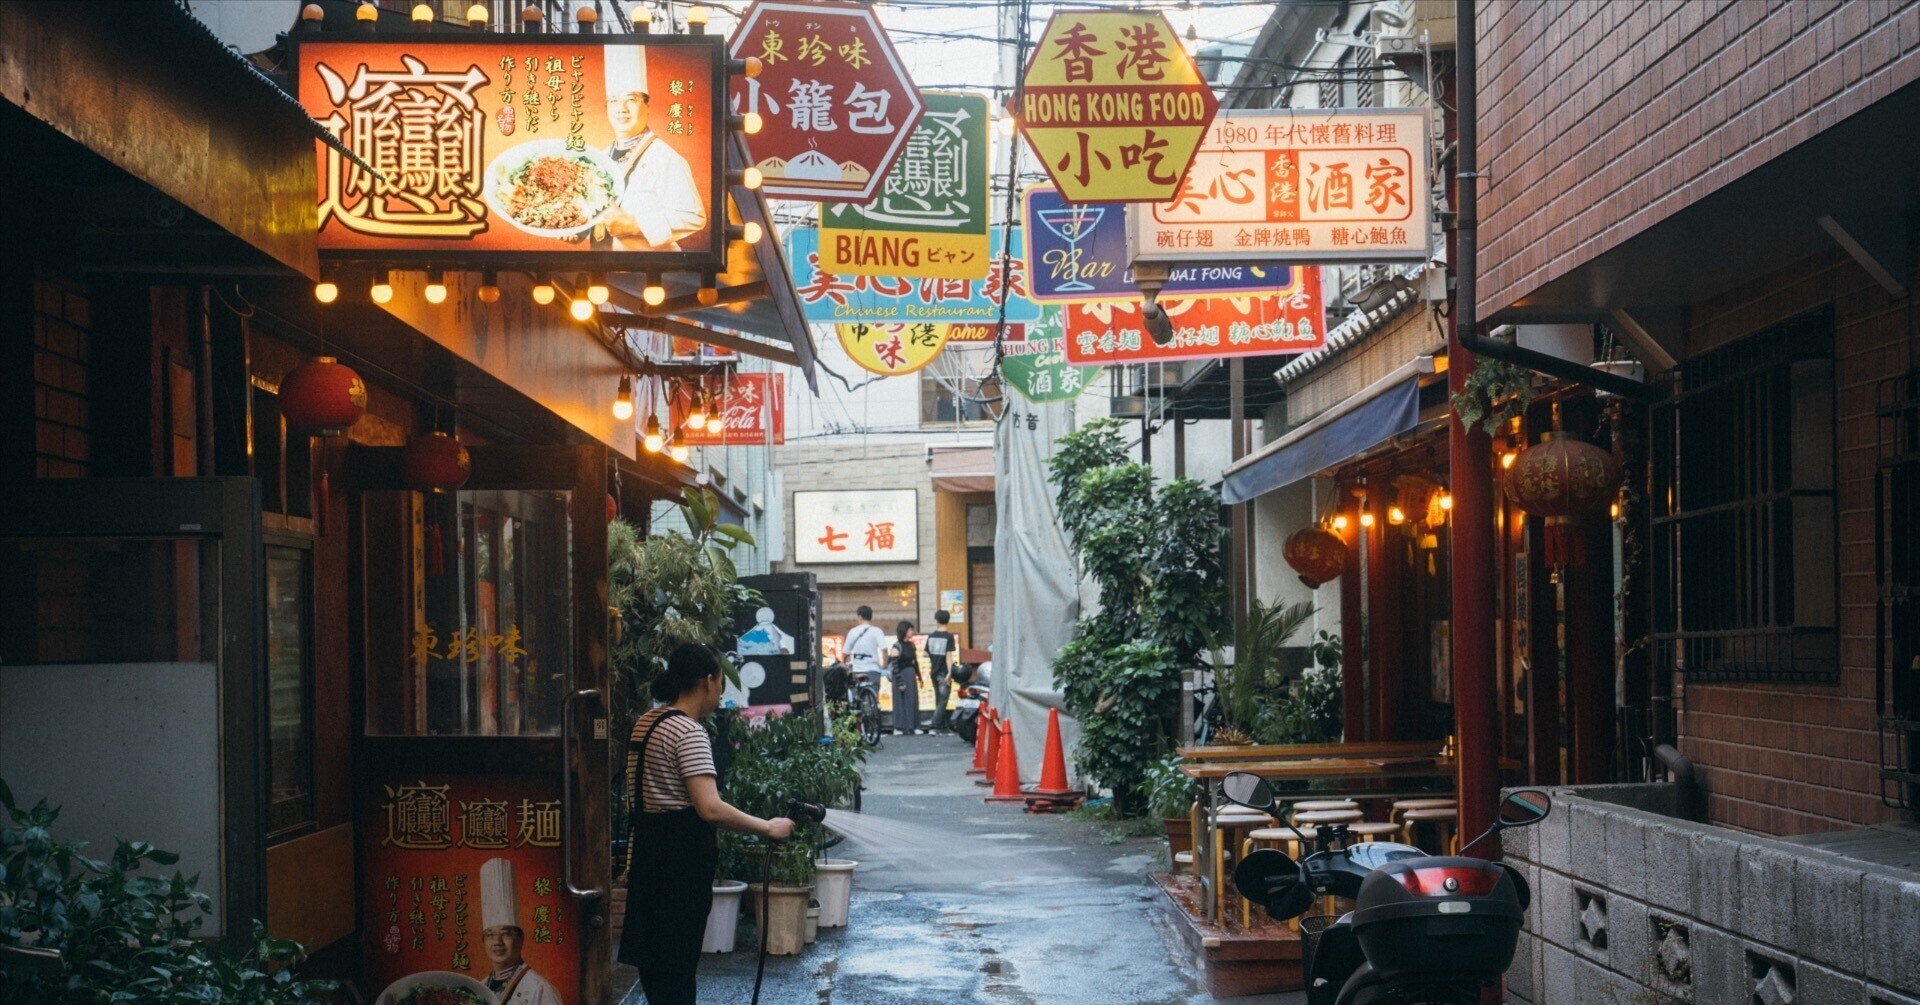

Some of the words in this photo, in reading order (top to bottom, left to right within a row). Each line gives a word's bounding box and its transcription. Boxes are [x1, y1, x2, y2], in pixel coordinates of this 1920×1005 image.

[758, 30, 872, 70] 東珍味
[1051, 22, 1172, 84] 香港
[498, 55, 517, 104] 作り方
[522, 56, 541, 133] 引き継いだ
[545, 55, 567, 122] 祖母から
[731, 77, 895, 135] 小籠包
[1024, 92, 1080, 123] HONG
[1086, 92, 1144, 122] KONG
[1149, 92, 1205, 121] FOOD
[1214, 125, 1259, 146] 1980
[1057, 129, 1177, 187] 小吃
[1269, 157, 1297, 203] 香港
[1305, 156, 1407, 214] 酒家
[836, 234, 920, 267] BIANG
[927, 248, 975, 264] ビャン
[1155, 228, 1214, 248] 碗仔翅
[1233, 228, 1311, 247] 金牌燒鴨
[1331, 227, 1408, 247] 糖心鮑魚
[1042, 248, 1116, 281] Bar
[1169, 268, 1197, 282] WAI
[1202, 267, 1242, 282] FONG
[834, 303, 898, 319] Chinese
[905, 303, 995, 318] Restaurant
[1003, 339, 1050, 357] HONG
[1027, 366, 1083, 396] 酒家
[818, 521, 896, 553] 七福
[410, 623, 528, 665] 東珍味
[385, 876, 402, 923] 作り方
[408, 876, 426, 951] 引き継いだ
[430, 875, 450, 941] 祖母から
